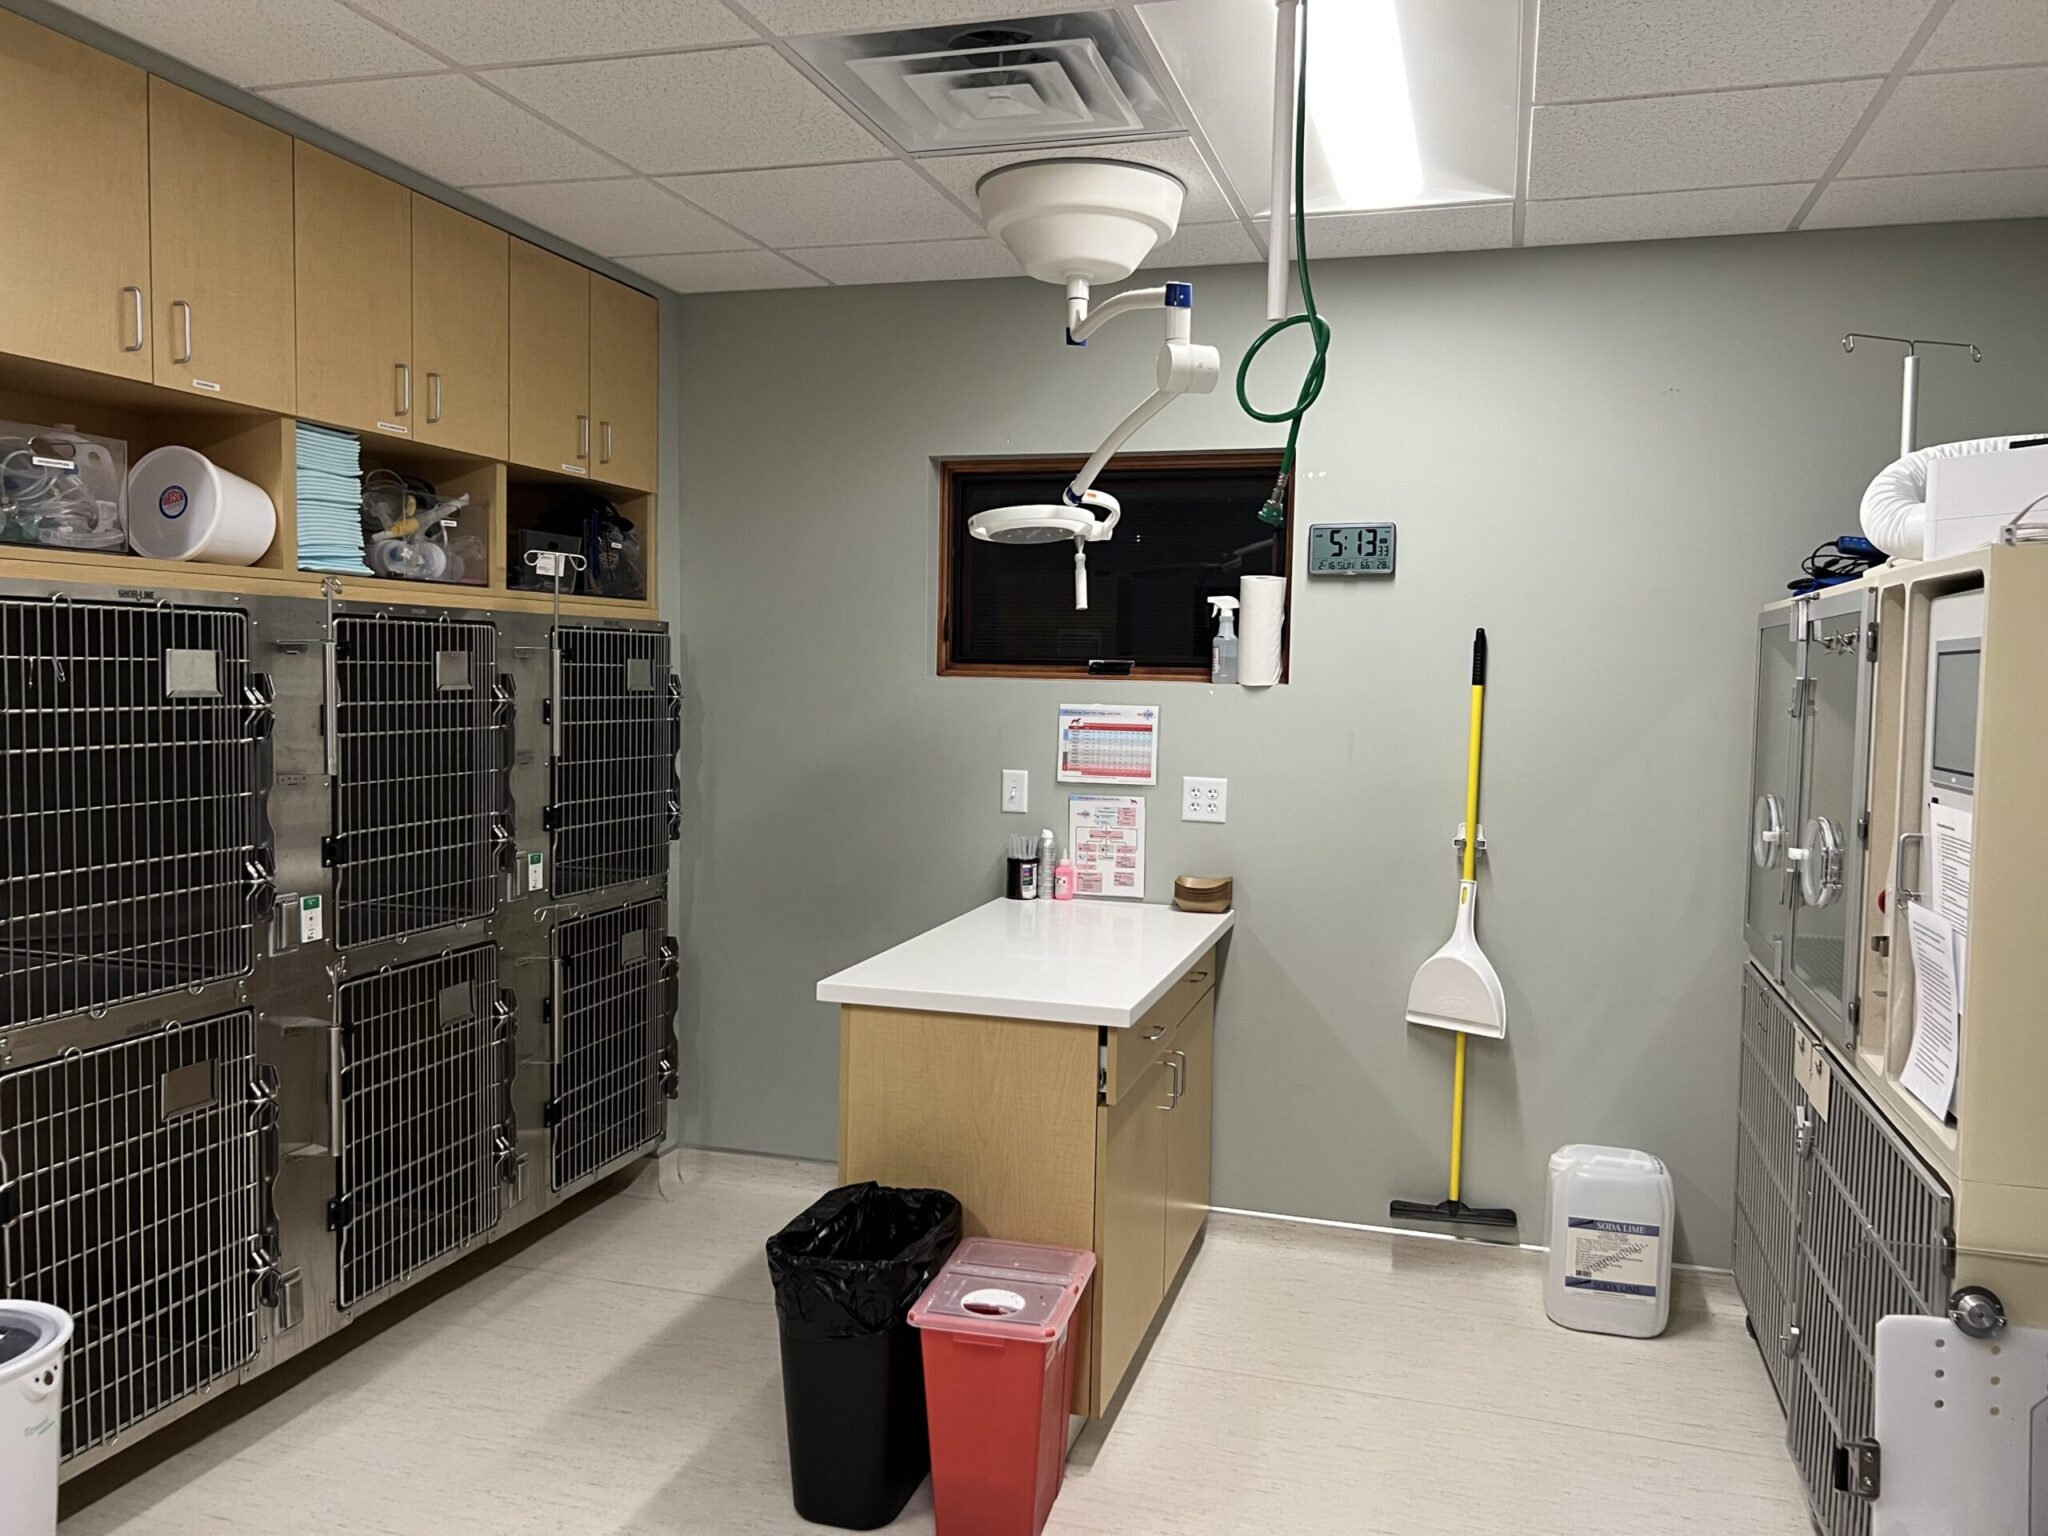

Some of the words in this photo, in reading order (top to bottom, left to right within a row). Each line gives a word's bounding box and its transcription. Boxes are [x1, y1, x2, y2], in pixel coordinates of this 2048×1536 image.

[1330, 529, 1377, 557] 5:13
[1378, 545, 1389, 557] 33
[1596, 1221, 1621, 1232] SODA
[1623, 1224, 1646, 1234] LIME
